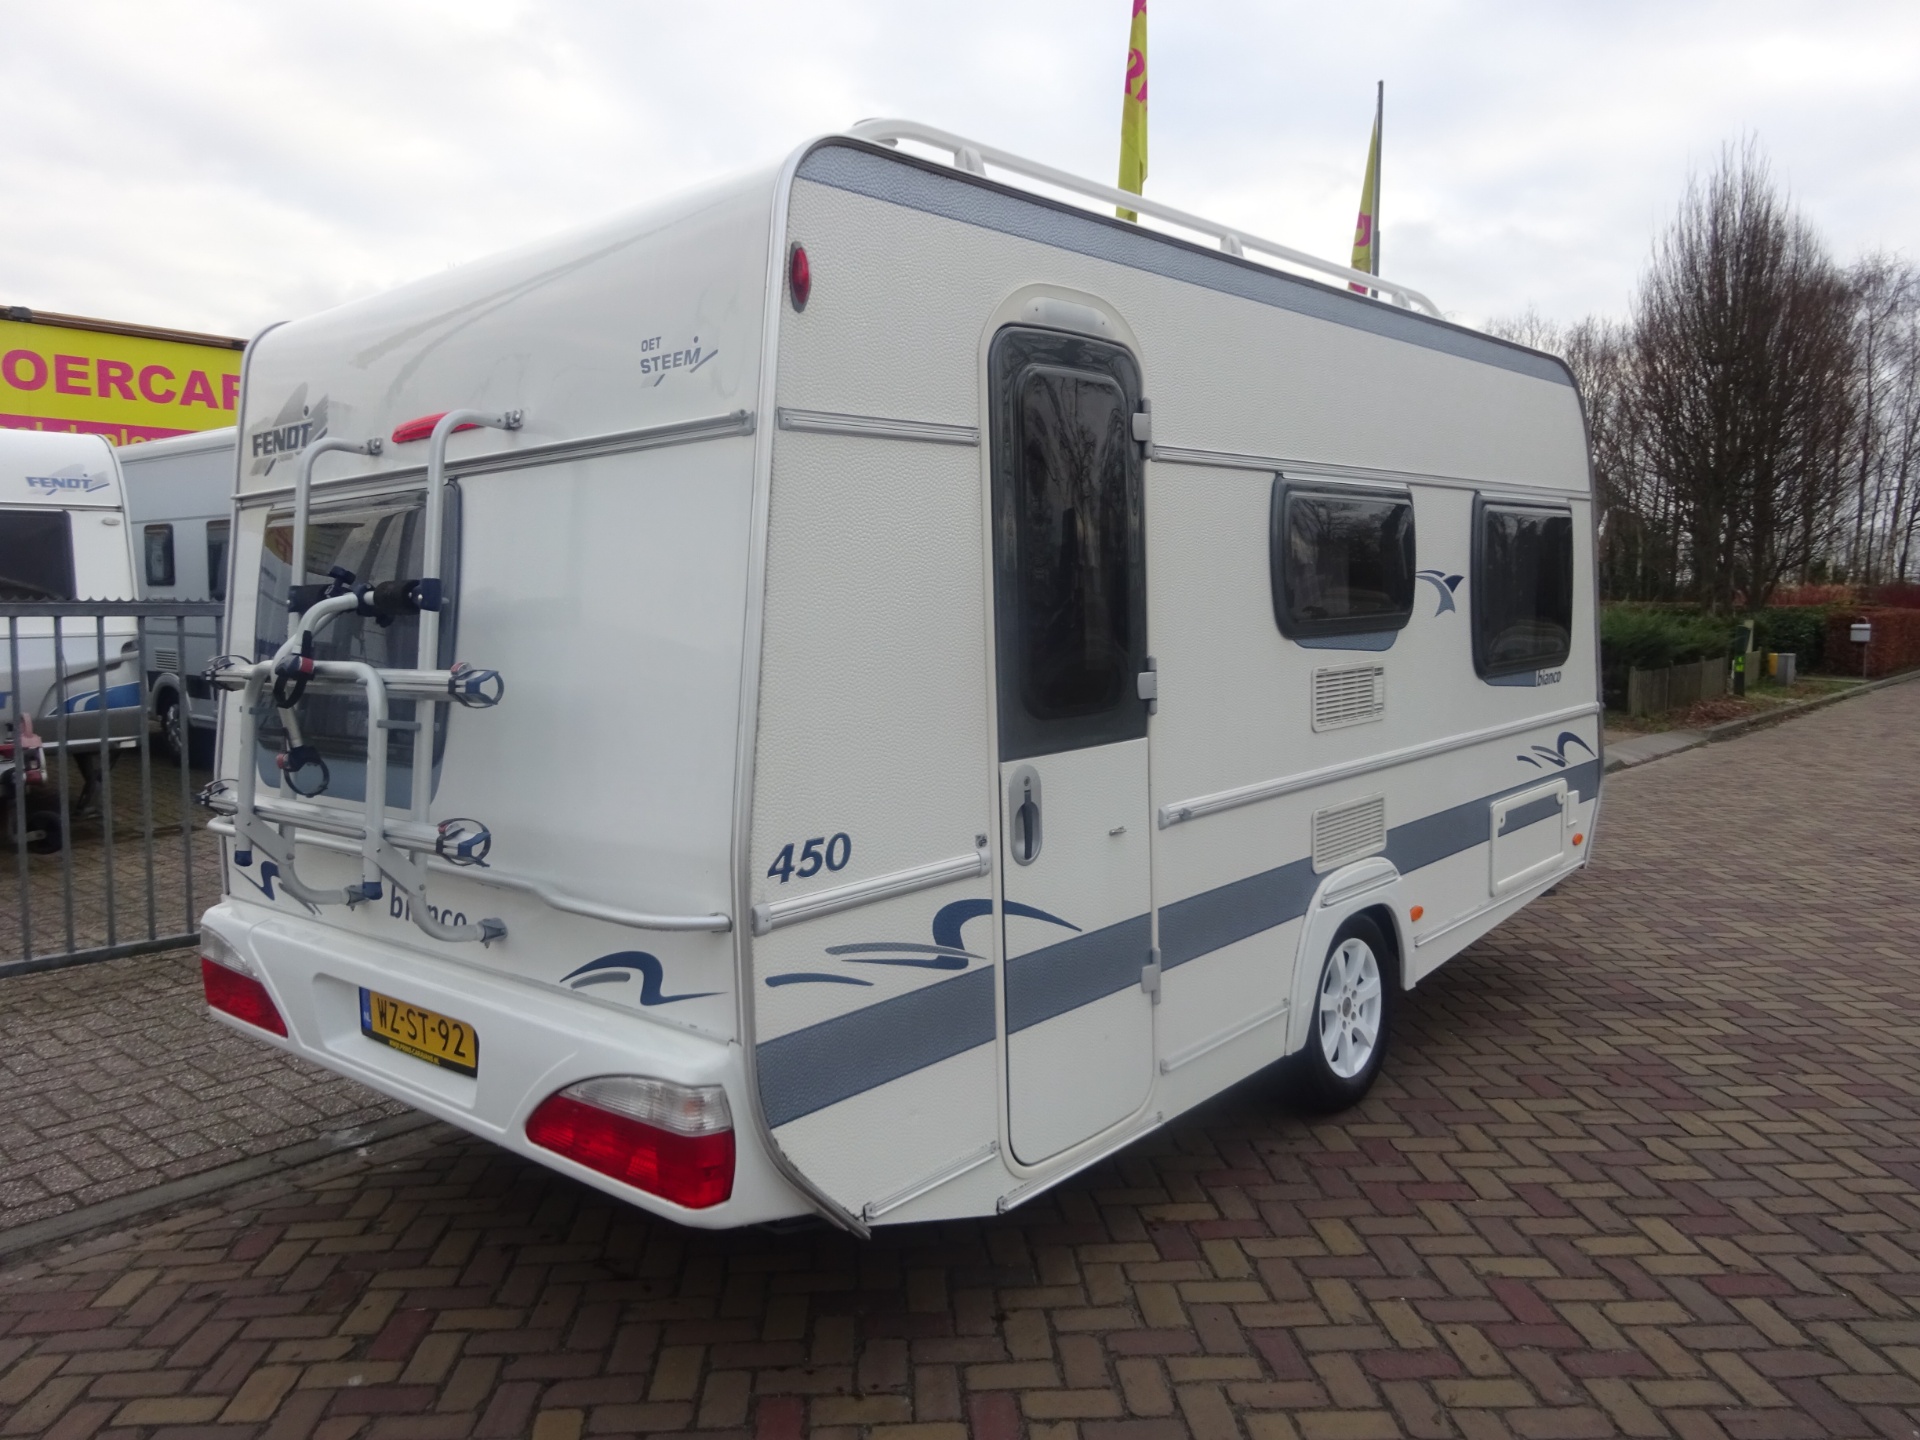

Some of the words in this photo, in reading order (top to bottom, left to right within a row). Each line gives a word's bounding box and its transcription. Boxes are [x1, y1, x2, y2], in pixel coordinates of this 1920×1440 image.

[640, 346, 702, 374] STEEM
[252, 422, 313, 458] FENDT
[25, 476, 93, 489] FENDT
[1537, 669, 1562, 687] bianco
[767, 832, 852, 885] 450
[390, 883, 467, 927] binco
[377, 997, 466, 1058] WZ-ST-92
